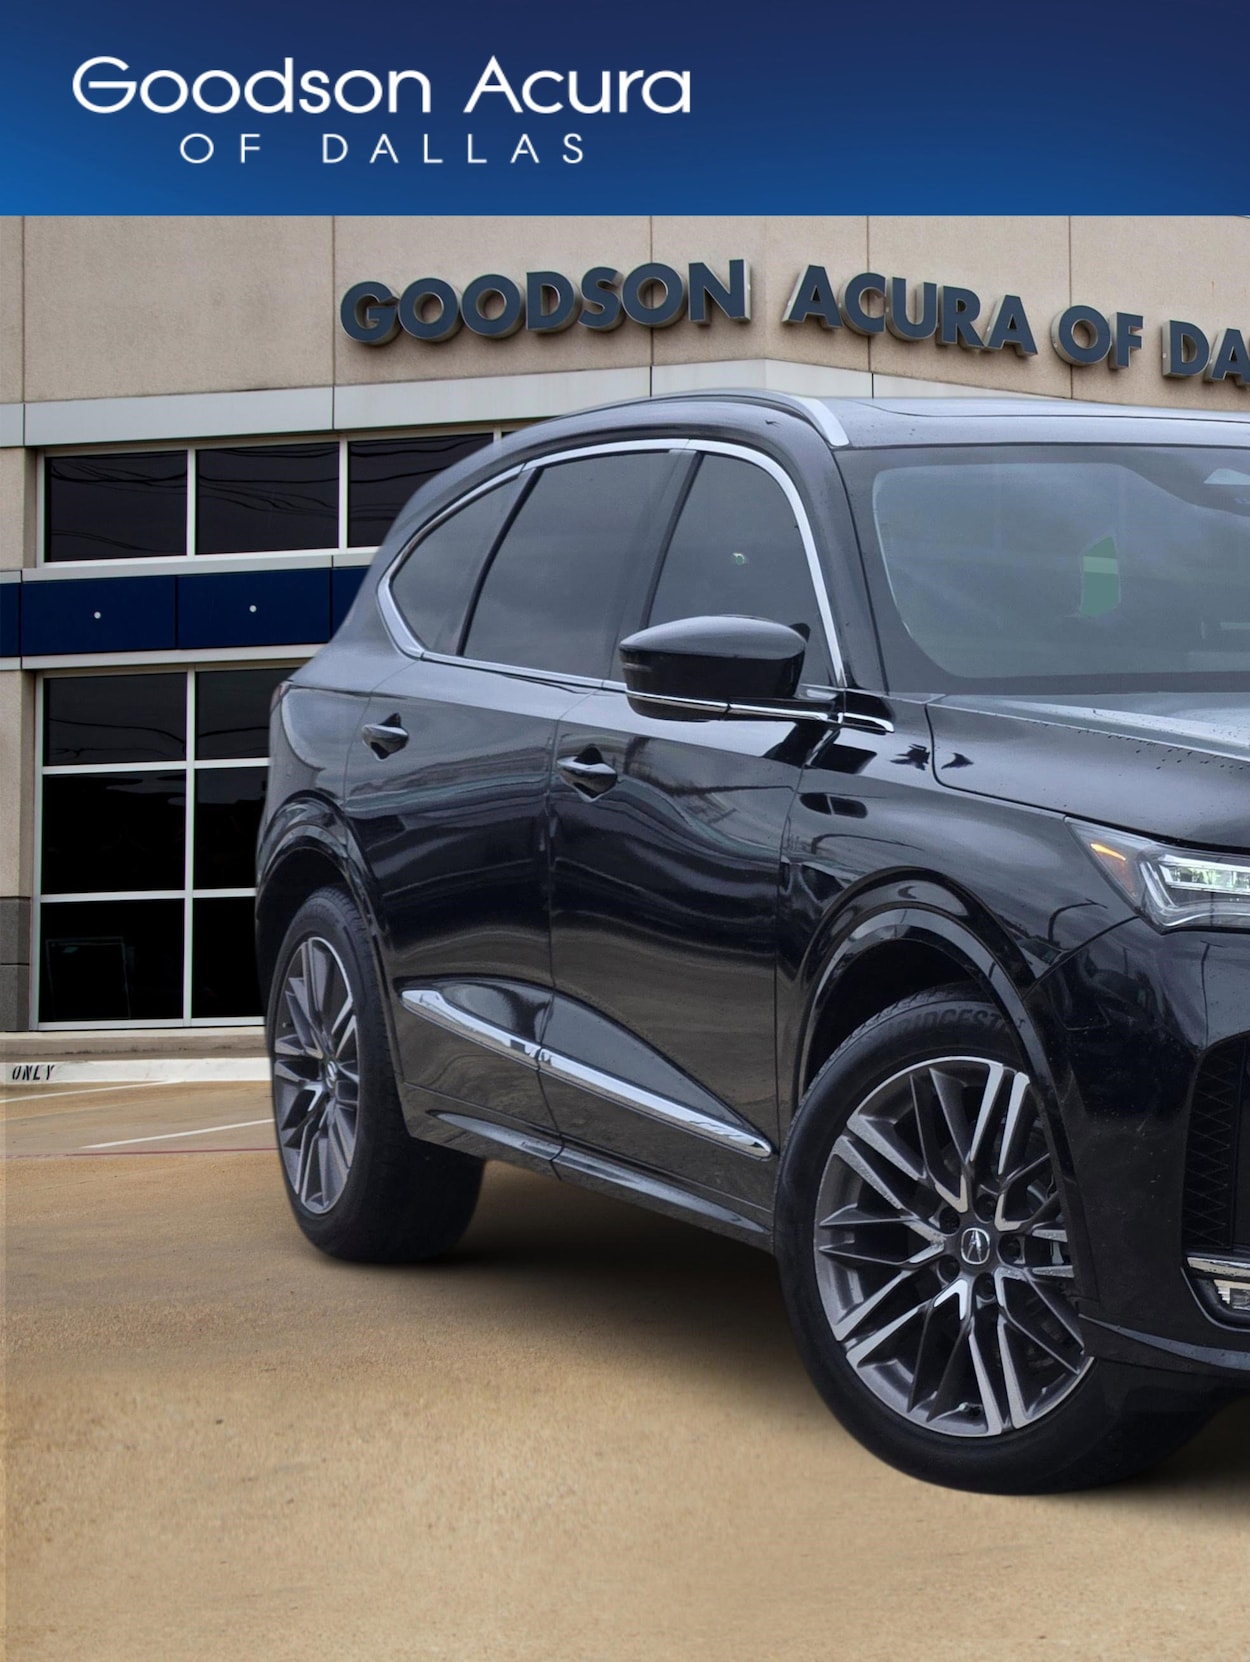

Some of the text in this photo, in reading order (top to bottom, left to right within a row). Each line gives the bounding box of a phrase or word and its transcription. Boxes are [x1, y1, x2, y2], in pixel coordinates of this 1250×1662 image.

[340, 259, 751, 347] GOODSON
[783, 264, 1038, 356] ACURA
[1051, 305, 1143, 367] OF
[12, 1064, 55, 1081] ONLY
